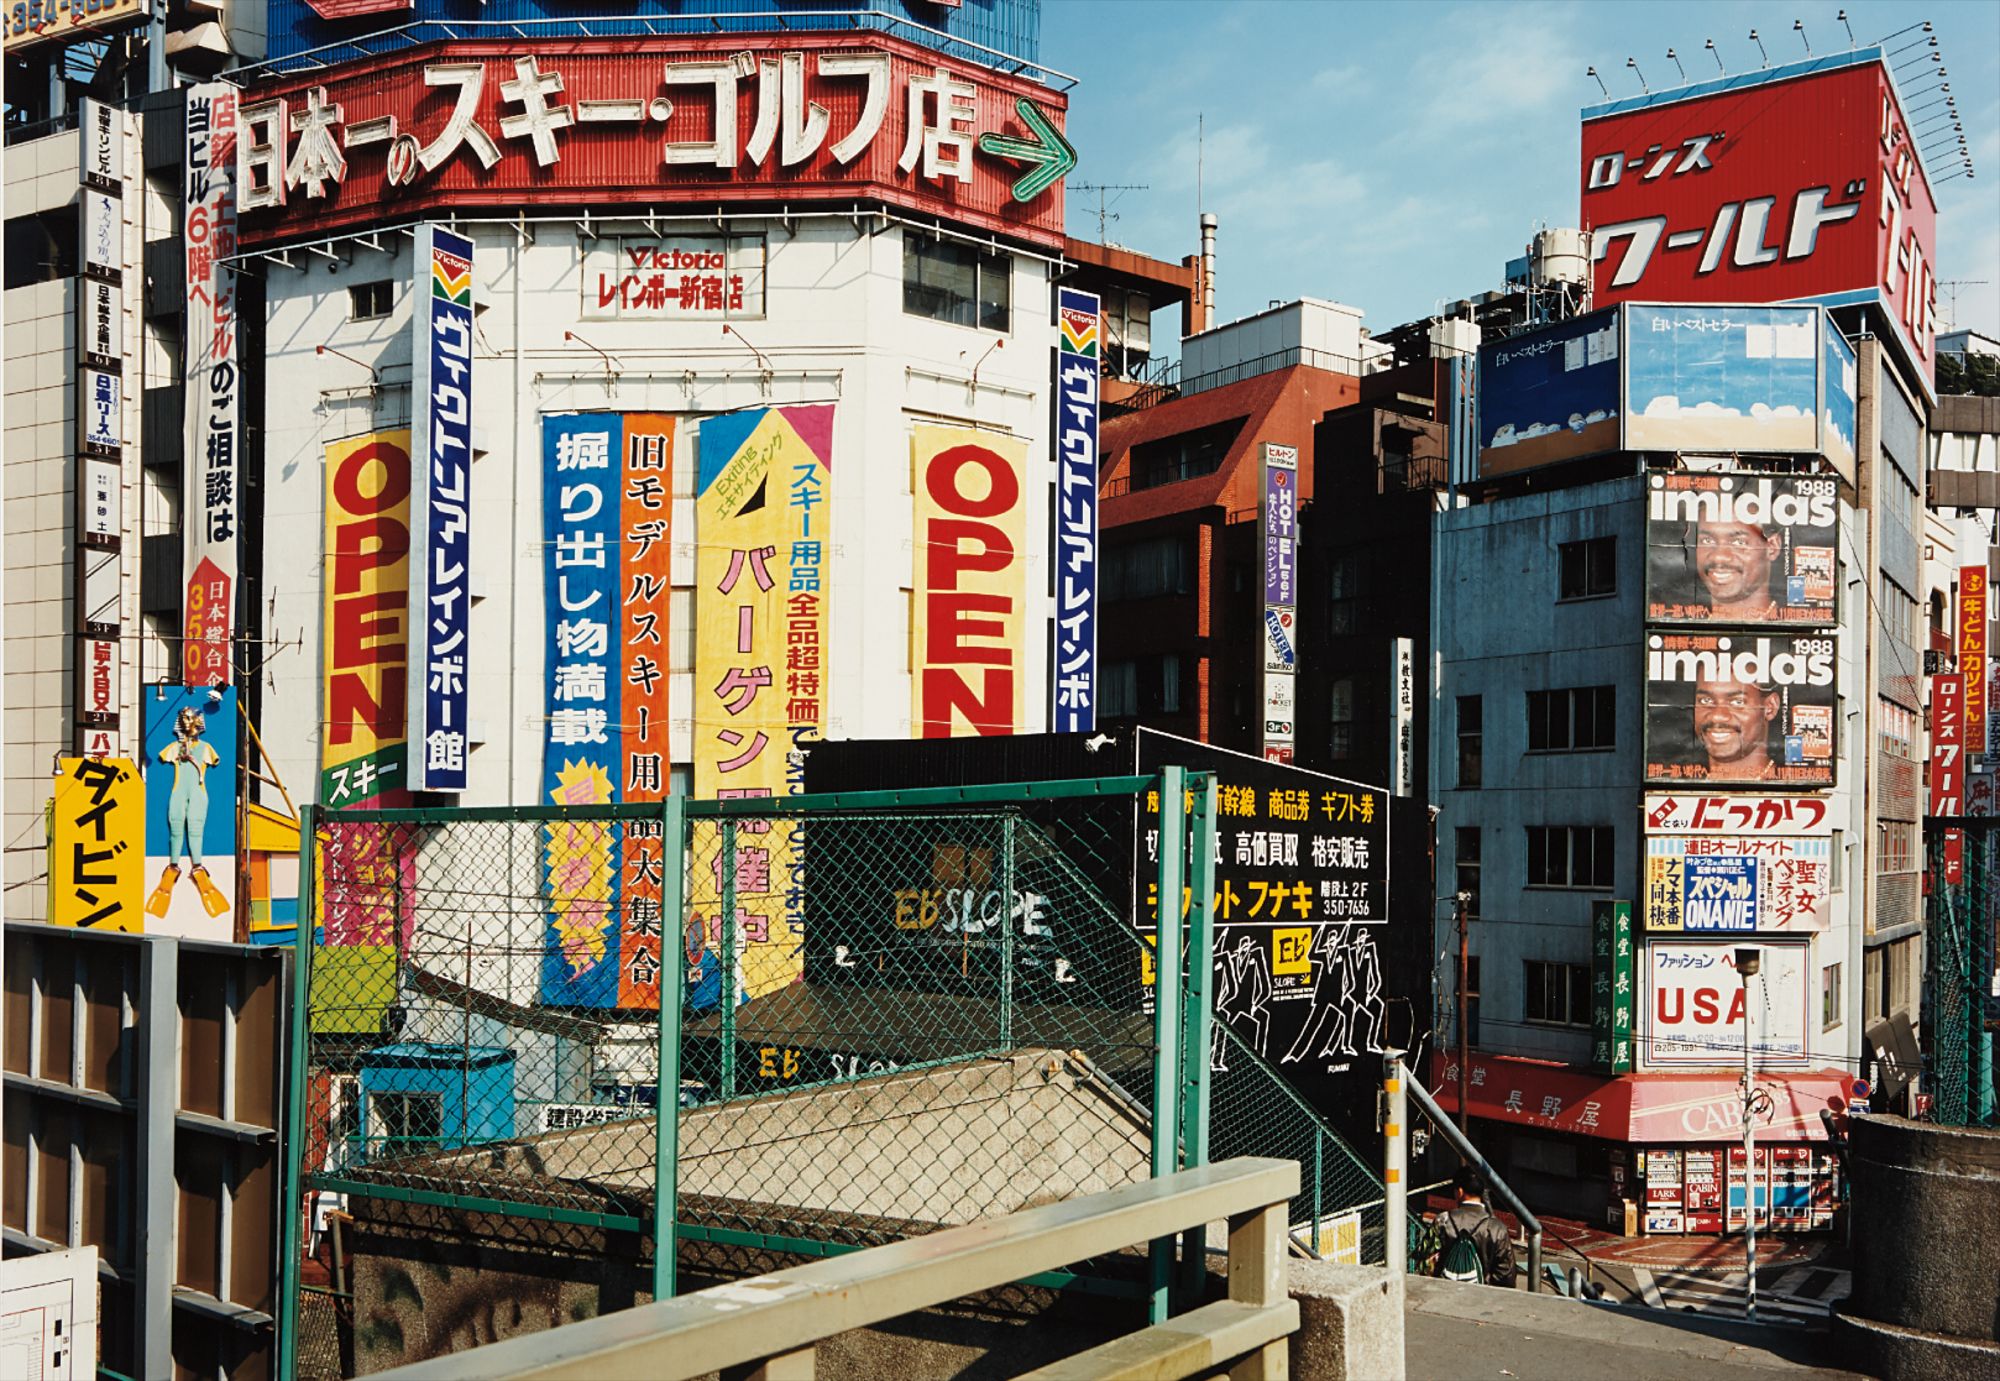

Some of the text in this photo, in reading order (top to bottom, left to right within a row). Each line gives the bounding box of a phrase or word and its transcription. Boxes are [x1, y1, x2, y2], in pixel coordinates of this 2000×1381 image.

[237, 51, 976, 213] 日本一のスキー・ゴルフ店
[1588, 131, 1726, 190] ローンズ
[188, 96, 211, 307] 当ビル6階へ
[1590, 179, 1866, 288] ワールド
[435, 250, 470, 272] Victoria
[625, 246, 726, 269] Victoria
[598, 273, 743, 310] レインボー新宿店
[1062, 310, 1096, 325] Victoria
[95, 375, 112, 436] 日東リース
[715, 446, 758, 497] Exiting
[715, 432, 783, 520] エキサイティング
[1795, 480, 1836, 496] 1988
[1650, 475, 1836, 527] imidas
[426, 310, 470, 771] ヴィクトリアレインボー館
[329, 441, 412, 745] OPEN
[550, 431, 609, 745] 掘り出し物満載
[922, 444, 1019, 739] OPEN
[1962, 598, 1982, 651] 牛どん
[1649, 635, 1834, 686] imidas
[1792, 639, 1833, 655] 1988
[1268, 722, 1281, 732] 3F
[1269, 788, 1310, 821] 商品券
[1321, 791, 1375, 824] ギフト券
[1663, 819, 1689, 829] となり
[1690, 798, 1827, 830] にっかつ
[73, 758, 130, 932] ダイビン
[1235, 831, 1298, 867] 高価買取
[1312, 834, 1369, 869] 格安販売
[1684, 839, 1793, 855] 連日オールナイト
[1248, 880, 1313, 919] フナキ
[1321, 881, 1369, 897] 階段上 2F
[1665, 858, 1682, 926] ナマ本番
[1688, 875, 1753, 900] スペシャル
[1774, 858, 1795, 928] ペッティング
[1795, 859, 1818, 914] 聖女
[1323, 900, 1370, 916] 350-7656
[1685, 899, 1755, 929] ONANIE
[1655, 953, 1715, 969] ファッション
[1614, 912, 1630, 1065] 食堂長野屋
[1657, 987, 1755, 1025] USA
[1653, 1190, 1677, 1198] LARK
[1689, 1183, 1719, 1193] CABIN
